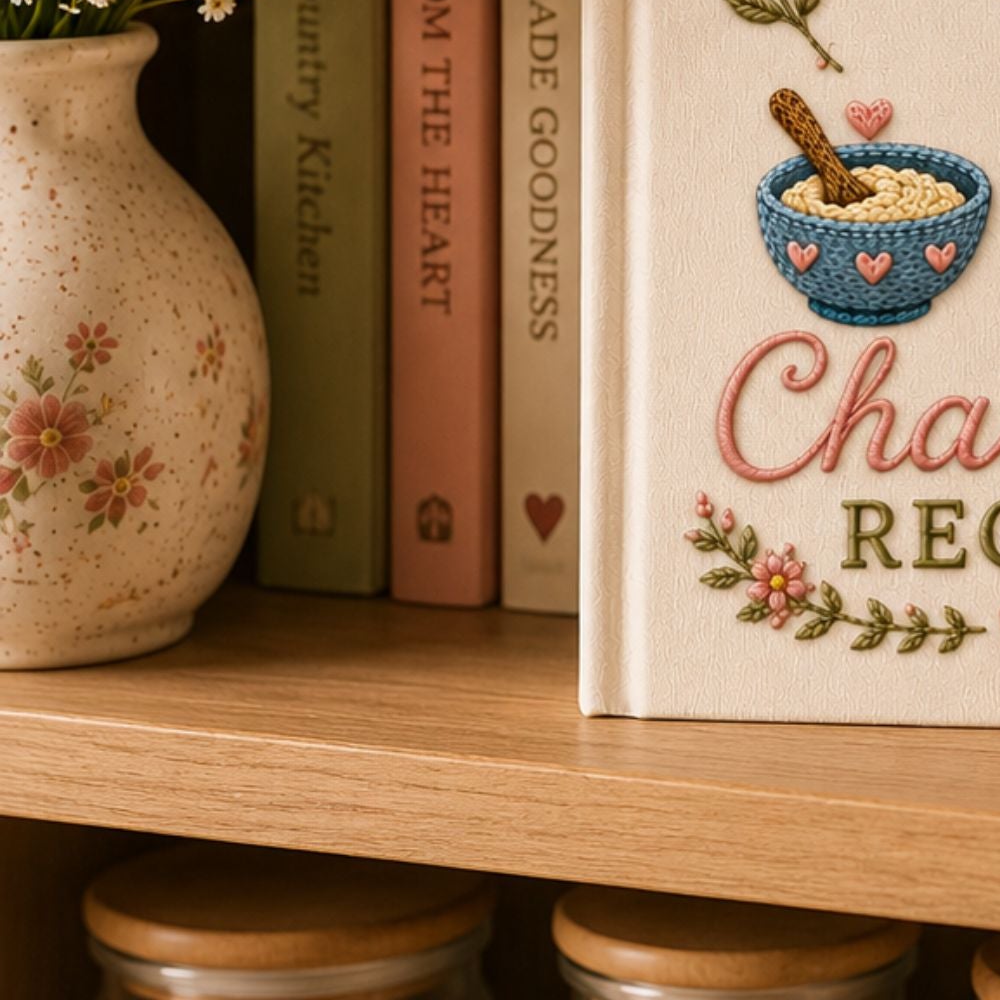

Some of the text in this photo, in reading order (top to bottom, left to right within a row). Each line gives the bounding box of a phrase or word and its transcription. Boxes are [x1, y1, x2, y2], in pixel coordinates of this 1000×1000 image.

[421, 59, 453, 147] THE
[297, 134, 333, 296] Kitchen
[420, 167, 453, 314] HEART
[528, 107, 560, 342] GOODNESS
